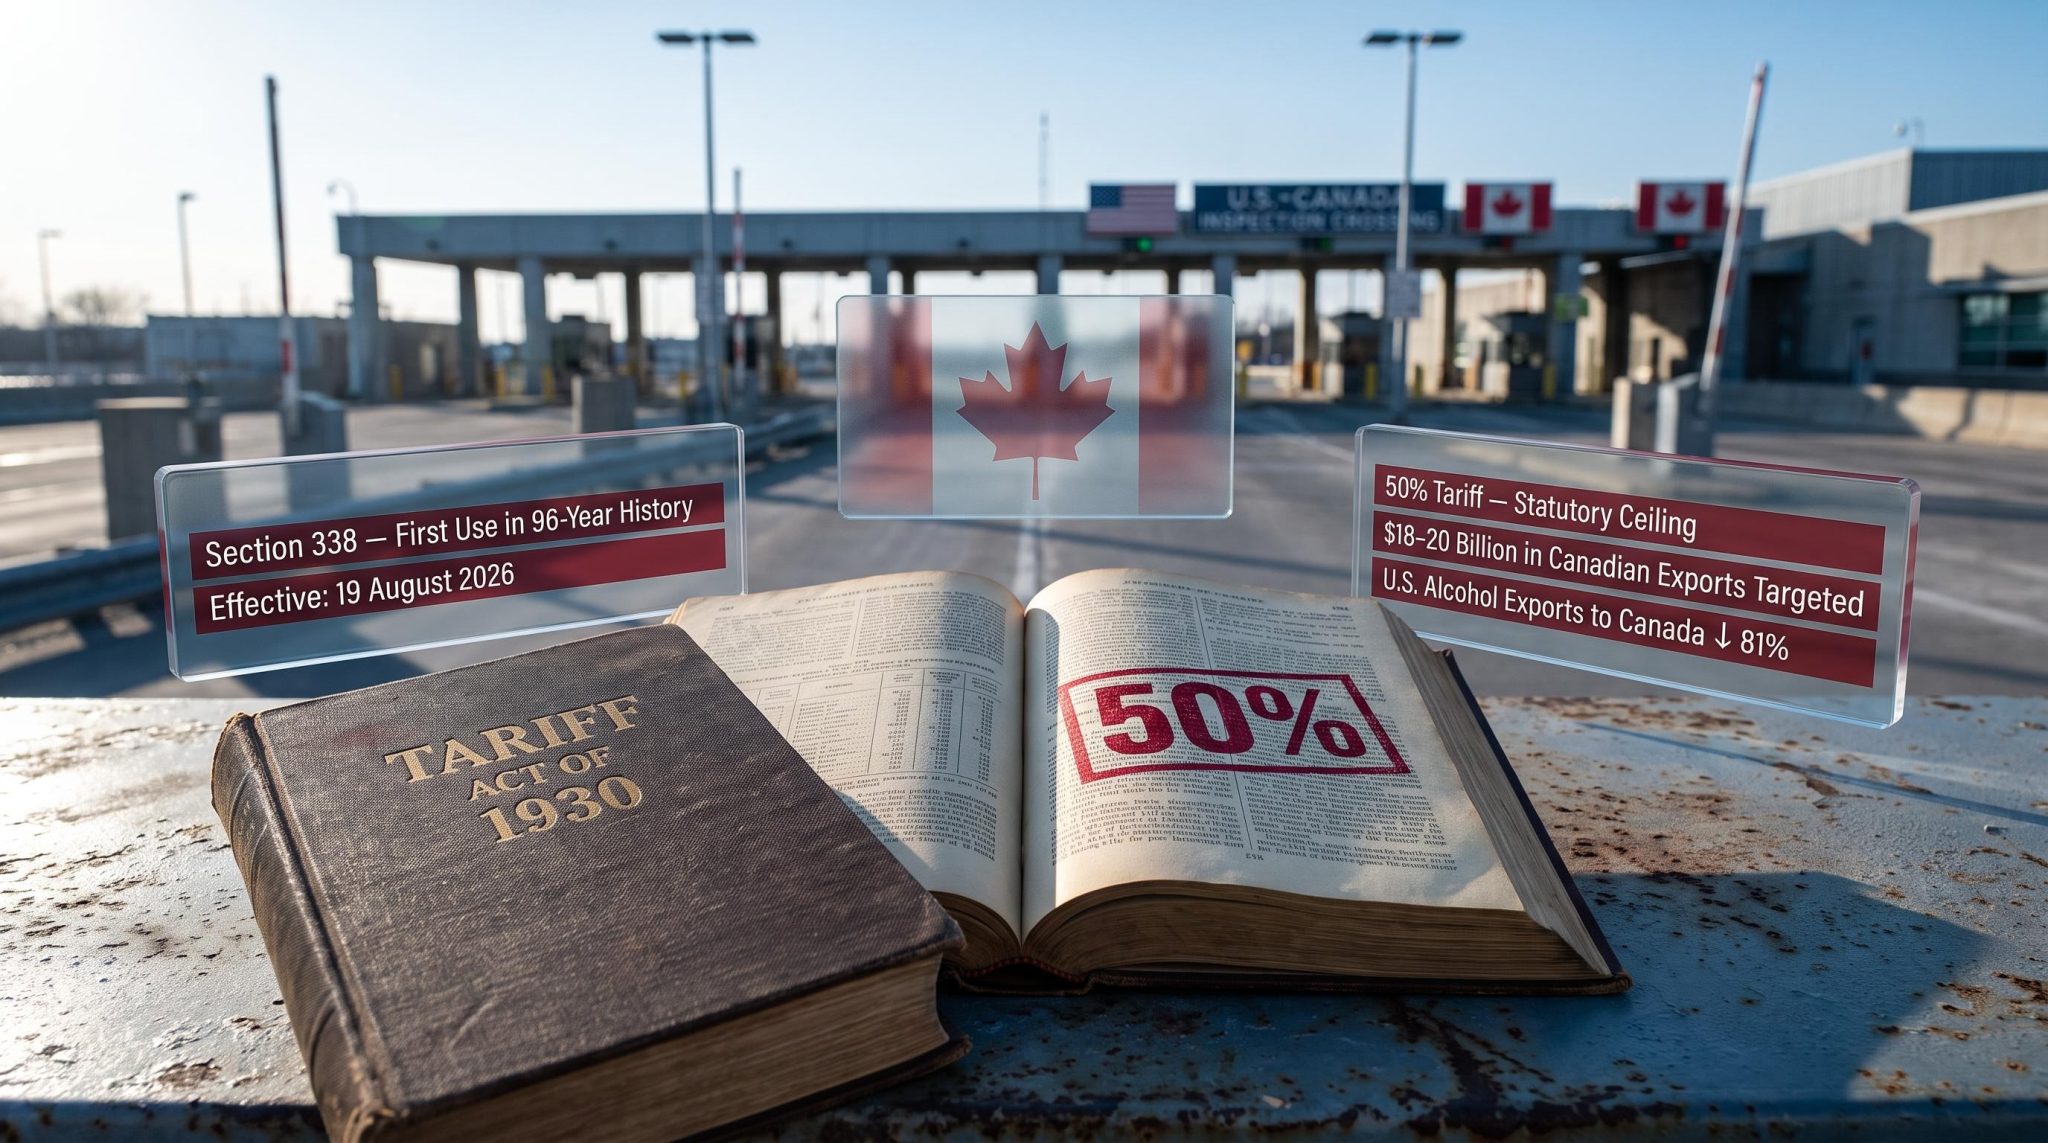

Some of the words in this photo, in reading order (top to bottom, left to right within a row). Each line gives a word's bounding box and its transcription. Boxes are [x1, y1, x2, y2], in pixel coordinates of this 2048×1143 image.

[1331, 211, 1439, 231] CROSSNG
[205, 535, 303, 568] Section
[311, 528, 357, 556] 338
[396, 519, 449, 548] First
[455, 516, 498, 541] Use
[505, 511, 524, 536] in
[532, 505, 613, 533] 96-Year
[620, 498, 693, 524] History
[1386, 474, 1428, 502] 50%
[1433, 479, 1483, 509] Tariff
[1514, 490, 1612, 532] Statutory
[1619, 503, 1697, 544] Ceiling
[210, 586, 329, 621] Effective:
[336, 579, 361, 606] 19
[368, 569, 453, 604] August
[459, 562, 514, 591] 2026
[1456, 531, 1517, 563] Billion
[1524, 540, 1542, 567] in
[1549, 545, 1650, 584] Canadian
[1658, 561, 1746, 599] Exports
[1753, 575, 1864, 617] Targeted
[1383, 567, 1418, 595] U.S.
[1424, 575, 1498, 609] Alcohol
[1505, 588, 1584, 624] Exports
[1590, 604, 1612, 629] to
[1619, 608, 1705, 646] Canada
[1740, 629, 1789, 661] 81%
[384, 695, 638, 783] TARIFF
[1095, 682, 1367, 758] 50%
[470, 762, 548, 800] ACT
[559, 746, 610, 774] OF
[479, 776, 642, 843] 1930
